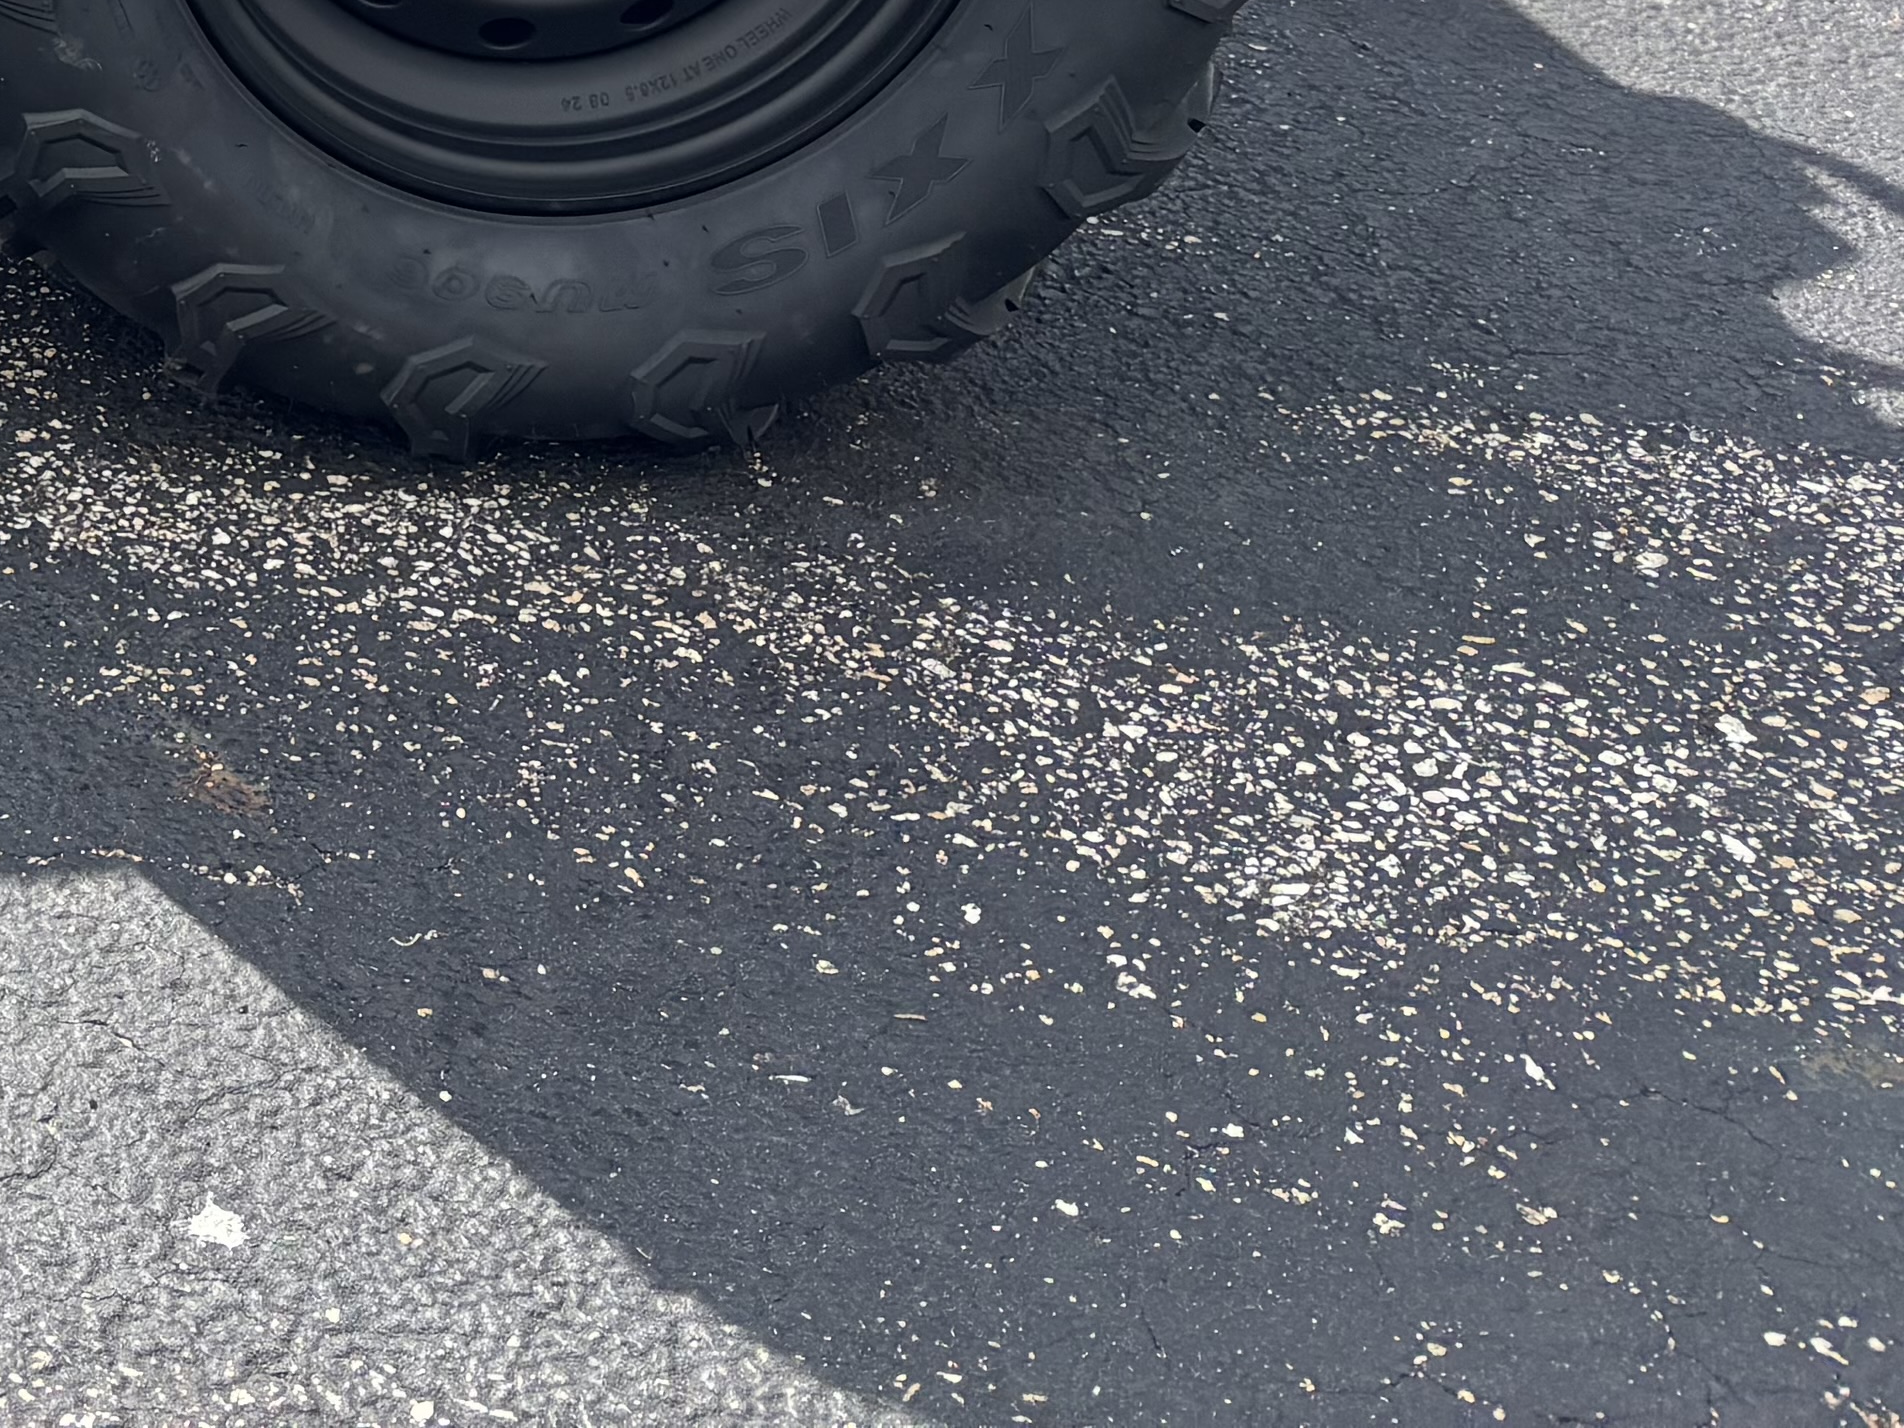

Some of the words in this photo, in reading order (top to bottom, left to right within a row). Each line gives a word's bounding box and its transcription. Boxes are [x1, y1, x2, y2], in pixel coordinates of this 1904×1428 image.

[735, 8, 793, 51] WHEEL
[679, 60, 703, 81] AT
[700, 41, 738, 72] ONE
[624, 71, 679, 100] 12X6.5
